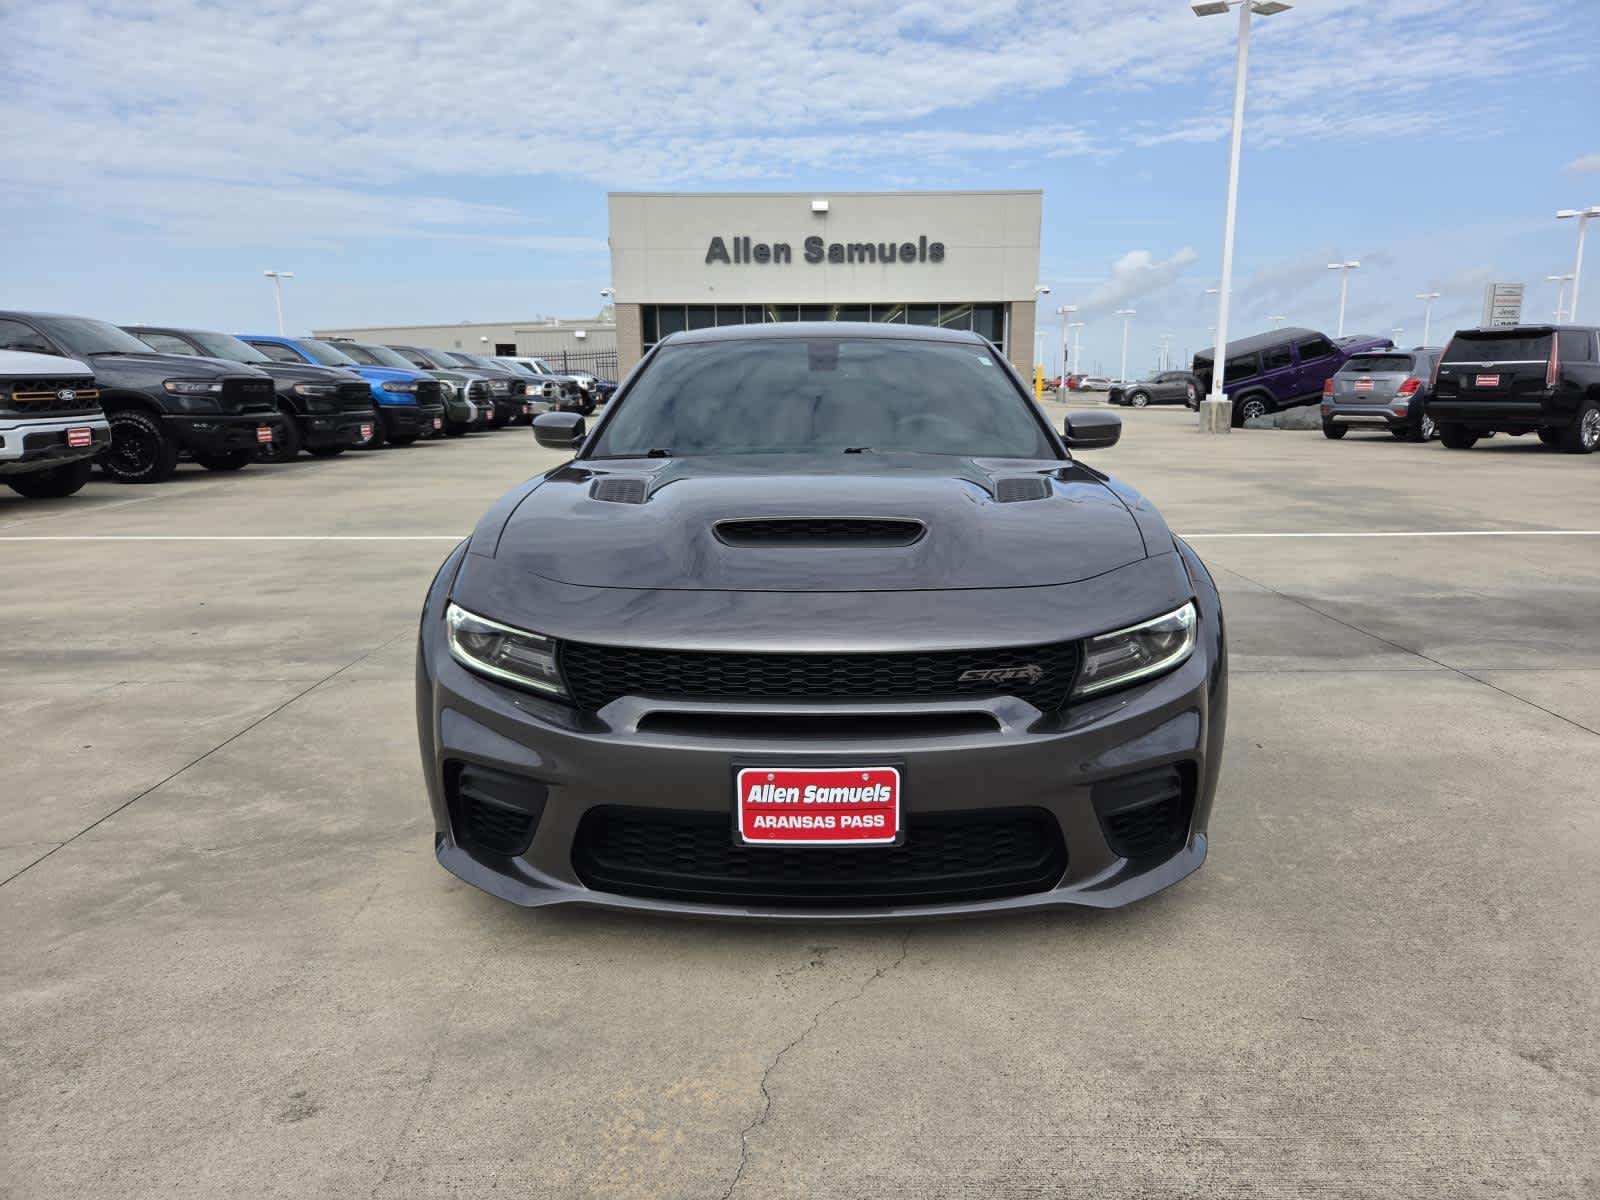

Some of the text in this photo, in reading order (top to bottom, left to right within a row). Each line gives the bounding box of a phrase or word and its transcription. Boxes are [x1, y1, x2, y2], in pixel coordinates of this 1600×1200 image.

[705, 235, 945, 264] Allen Samuels
[747, 783, 892, 804] Allen Samuels
[753, 814, 885, 829] ARANSAS PASS
